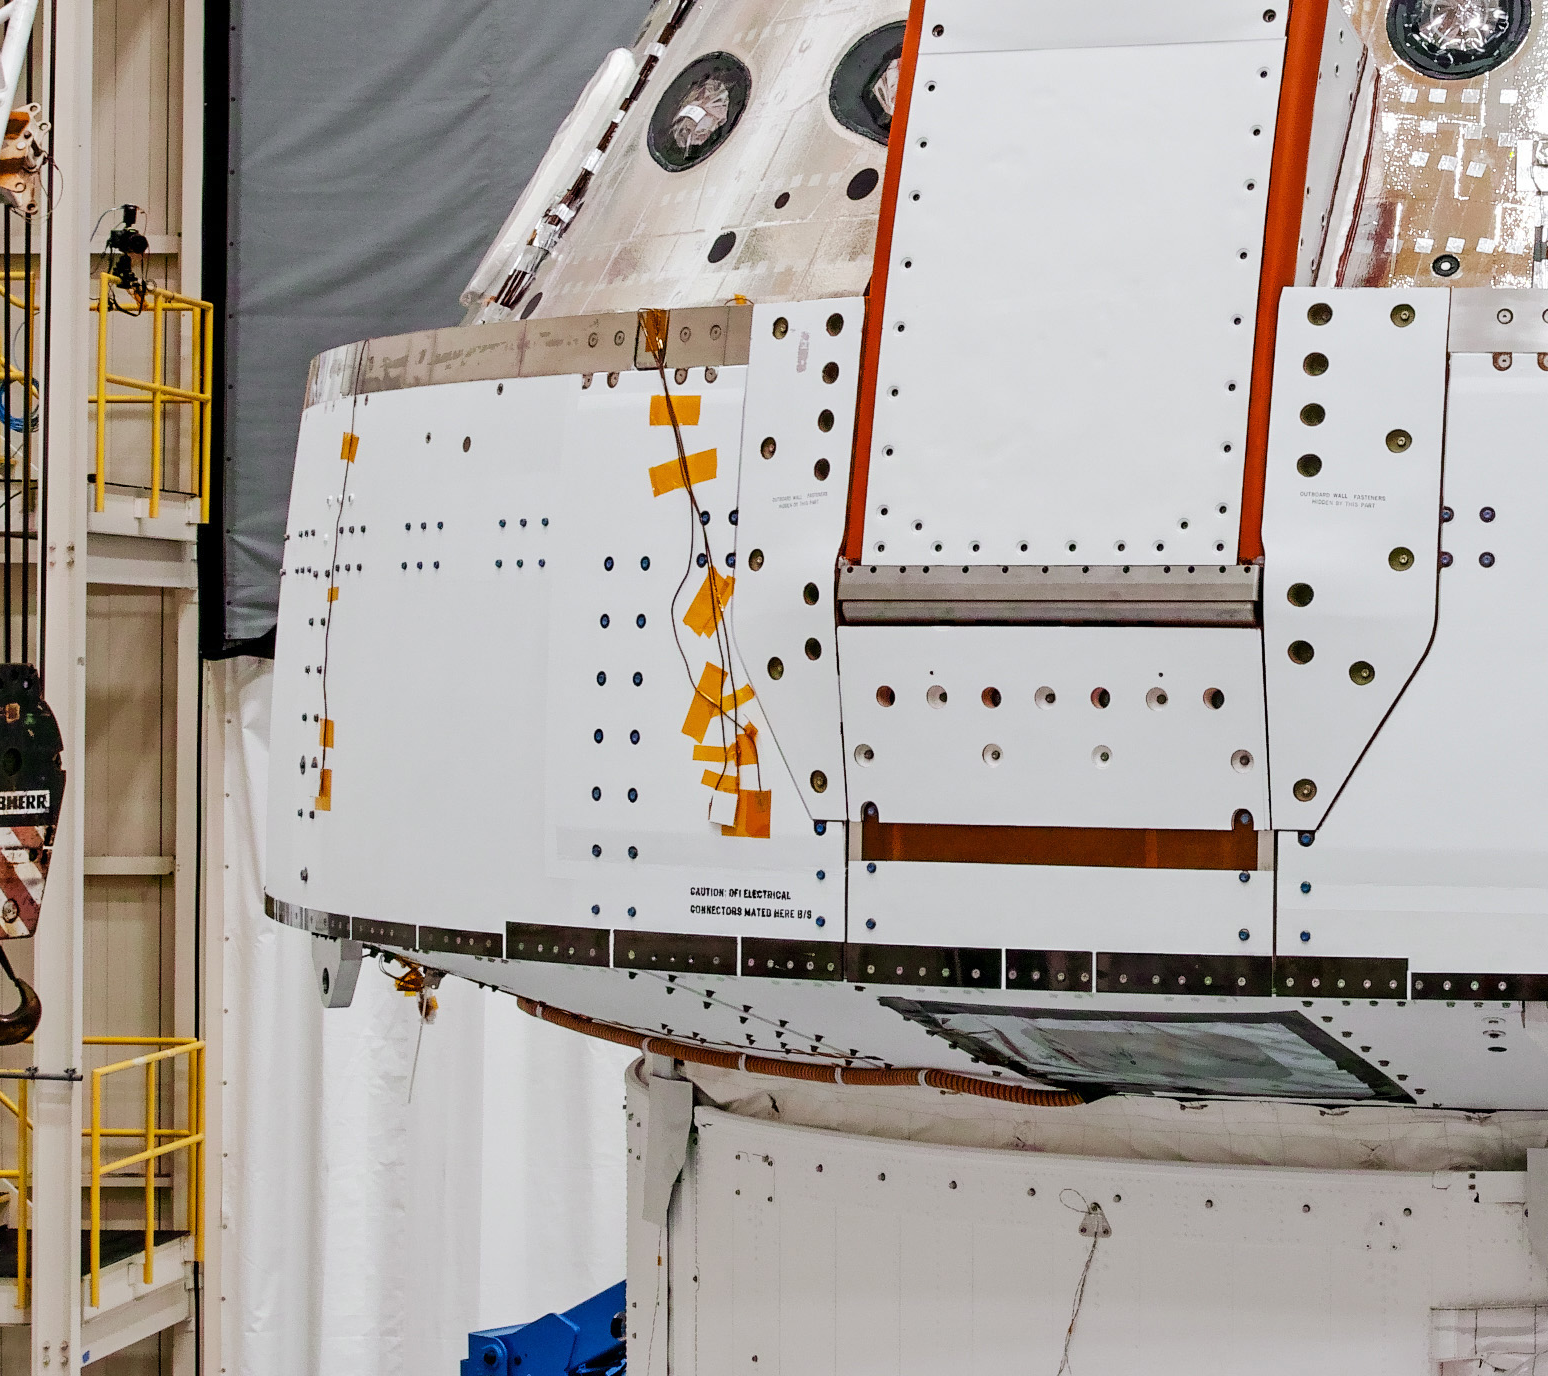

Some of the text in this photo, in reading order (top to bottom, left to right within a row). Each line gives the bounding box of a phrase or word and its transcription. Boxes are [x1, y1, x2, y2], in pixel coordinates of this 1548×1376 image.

[1353, 494, 1386, 502] FASTENERS
[690, 887, 727, 898] CAUTION:
[743, 889, 791, 900] ELECTRICAL
[690, 905, 742, 916] CONNECTORS
[744, 907, 772, 918] MATED
[773, 908, 795, 919] HERE
